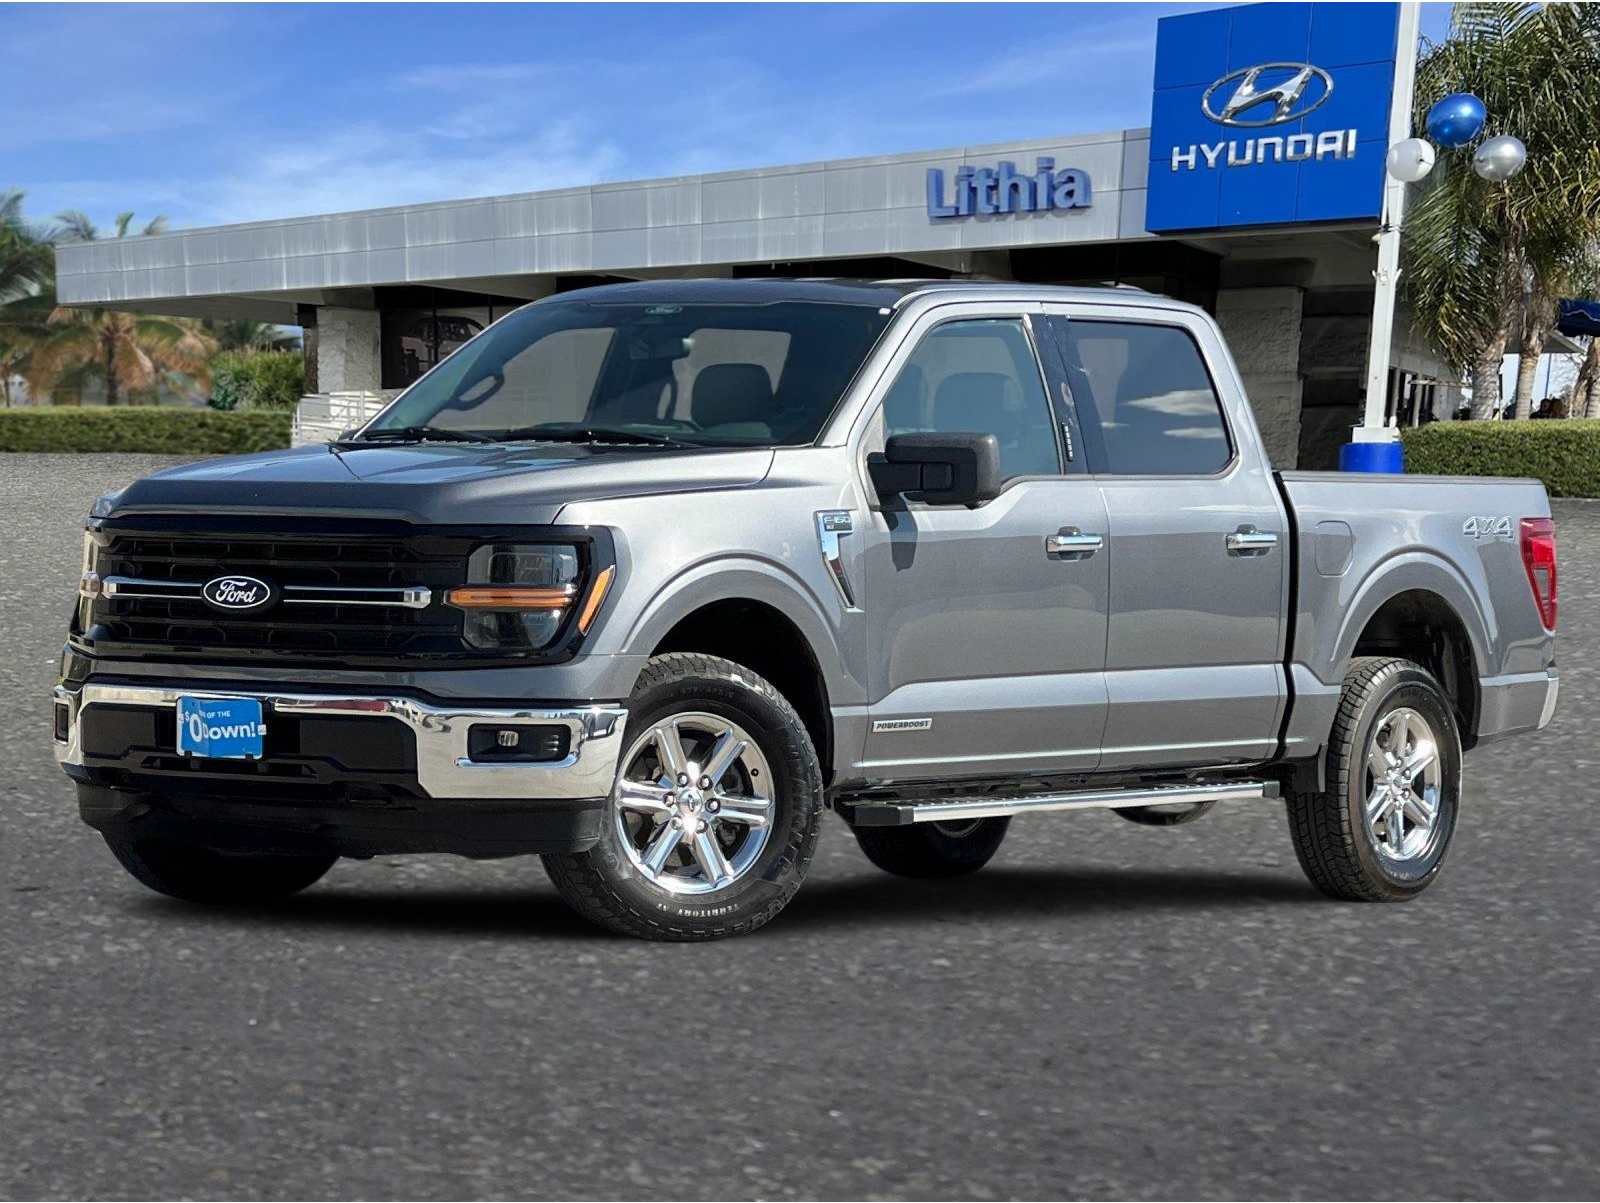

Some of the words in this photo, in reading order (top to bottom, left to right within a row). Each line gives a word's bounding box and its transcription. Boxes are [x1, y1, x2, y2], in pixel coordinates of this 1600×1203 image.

[1171, 129, 1357, 171] HYUNDAI
[926, 157, 1093, 219] Lithia
[215, 580, 257, 602] Ford
[206, 711, 216, 719] OF
[217, 710, 231, 718] THE
[876, 720, 929, 729] POWERBOOST
